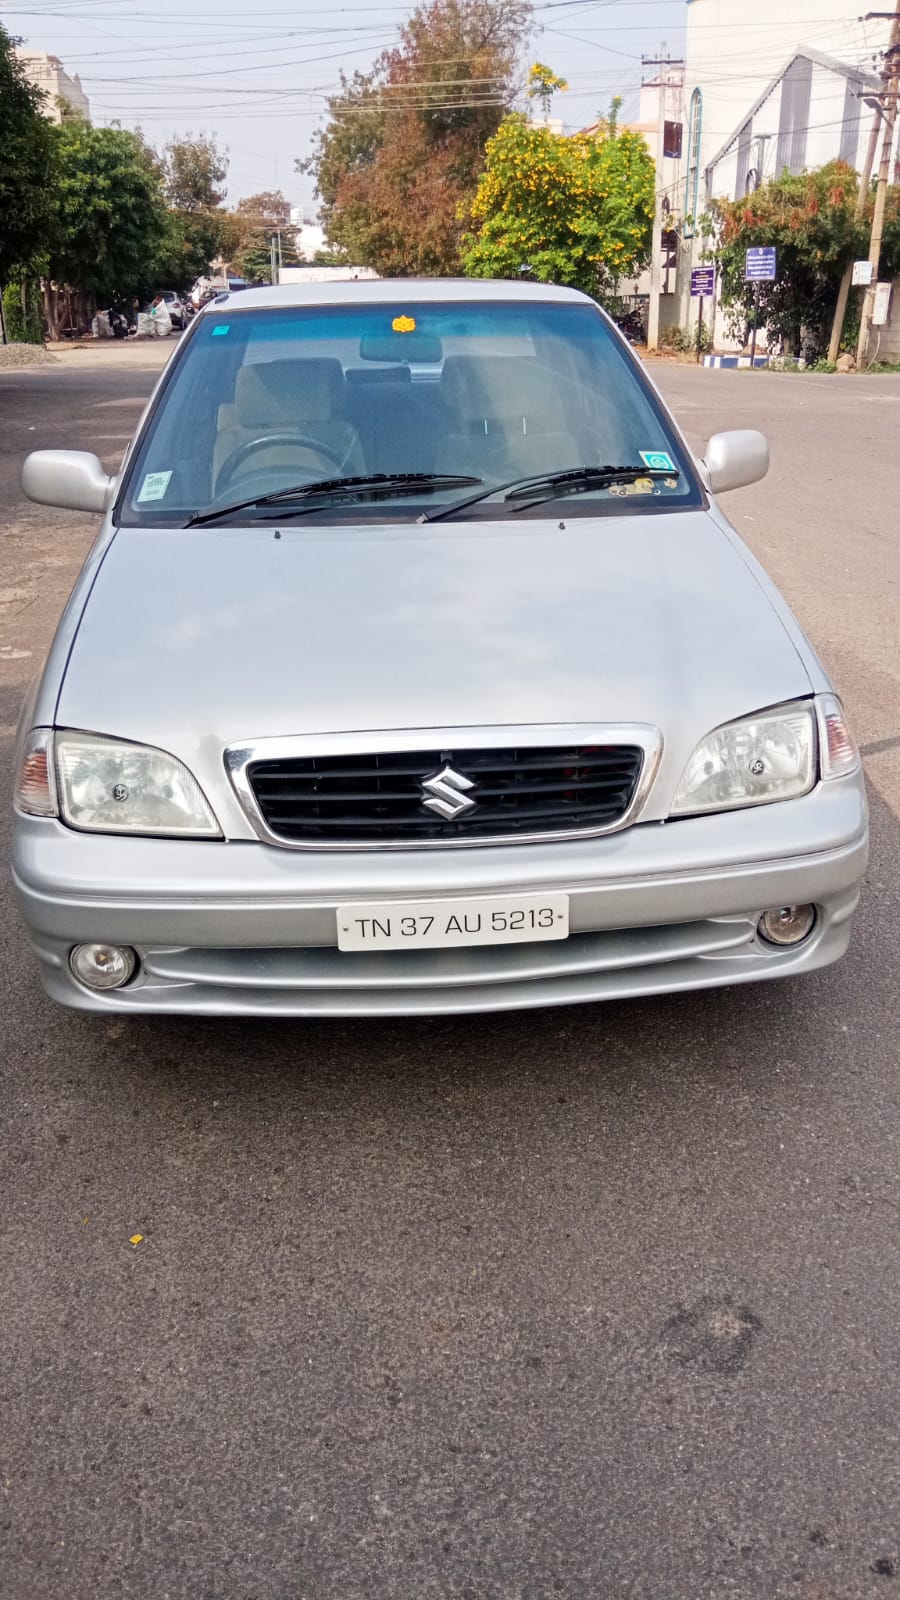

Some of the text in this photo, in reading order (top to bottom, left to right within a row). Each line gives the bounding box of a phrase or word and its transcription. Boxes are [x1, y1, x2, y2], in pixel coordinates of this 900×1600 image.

[354, 908, 554, 938] TN 37 AU 5213
